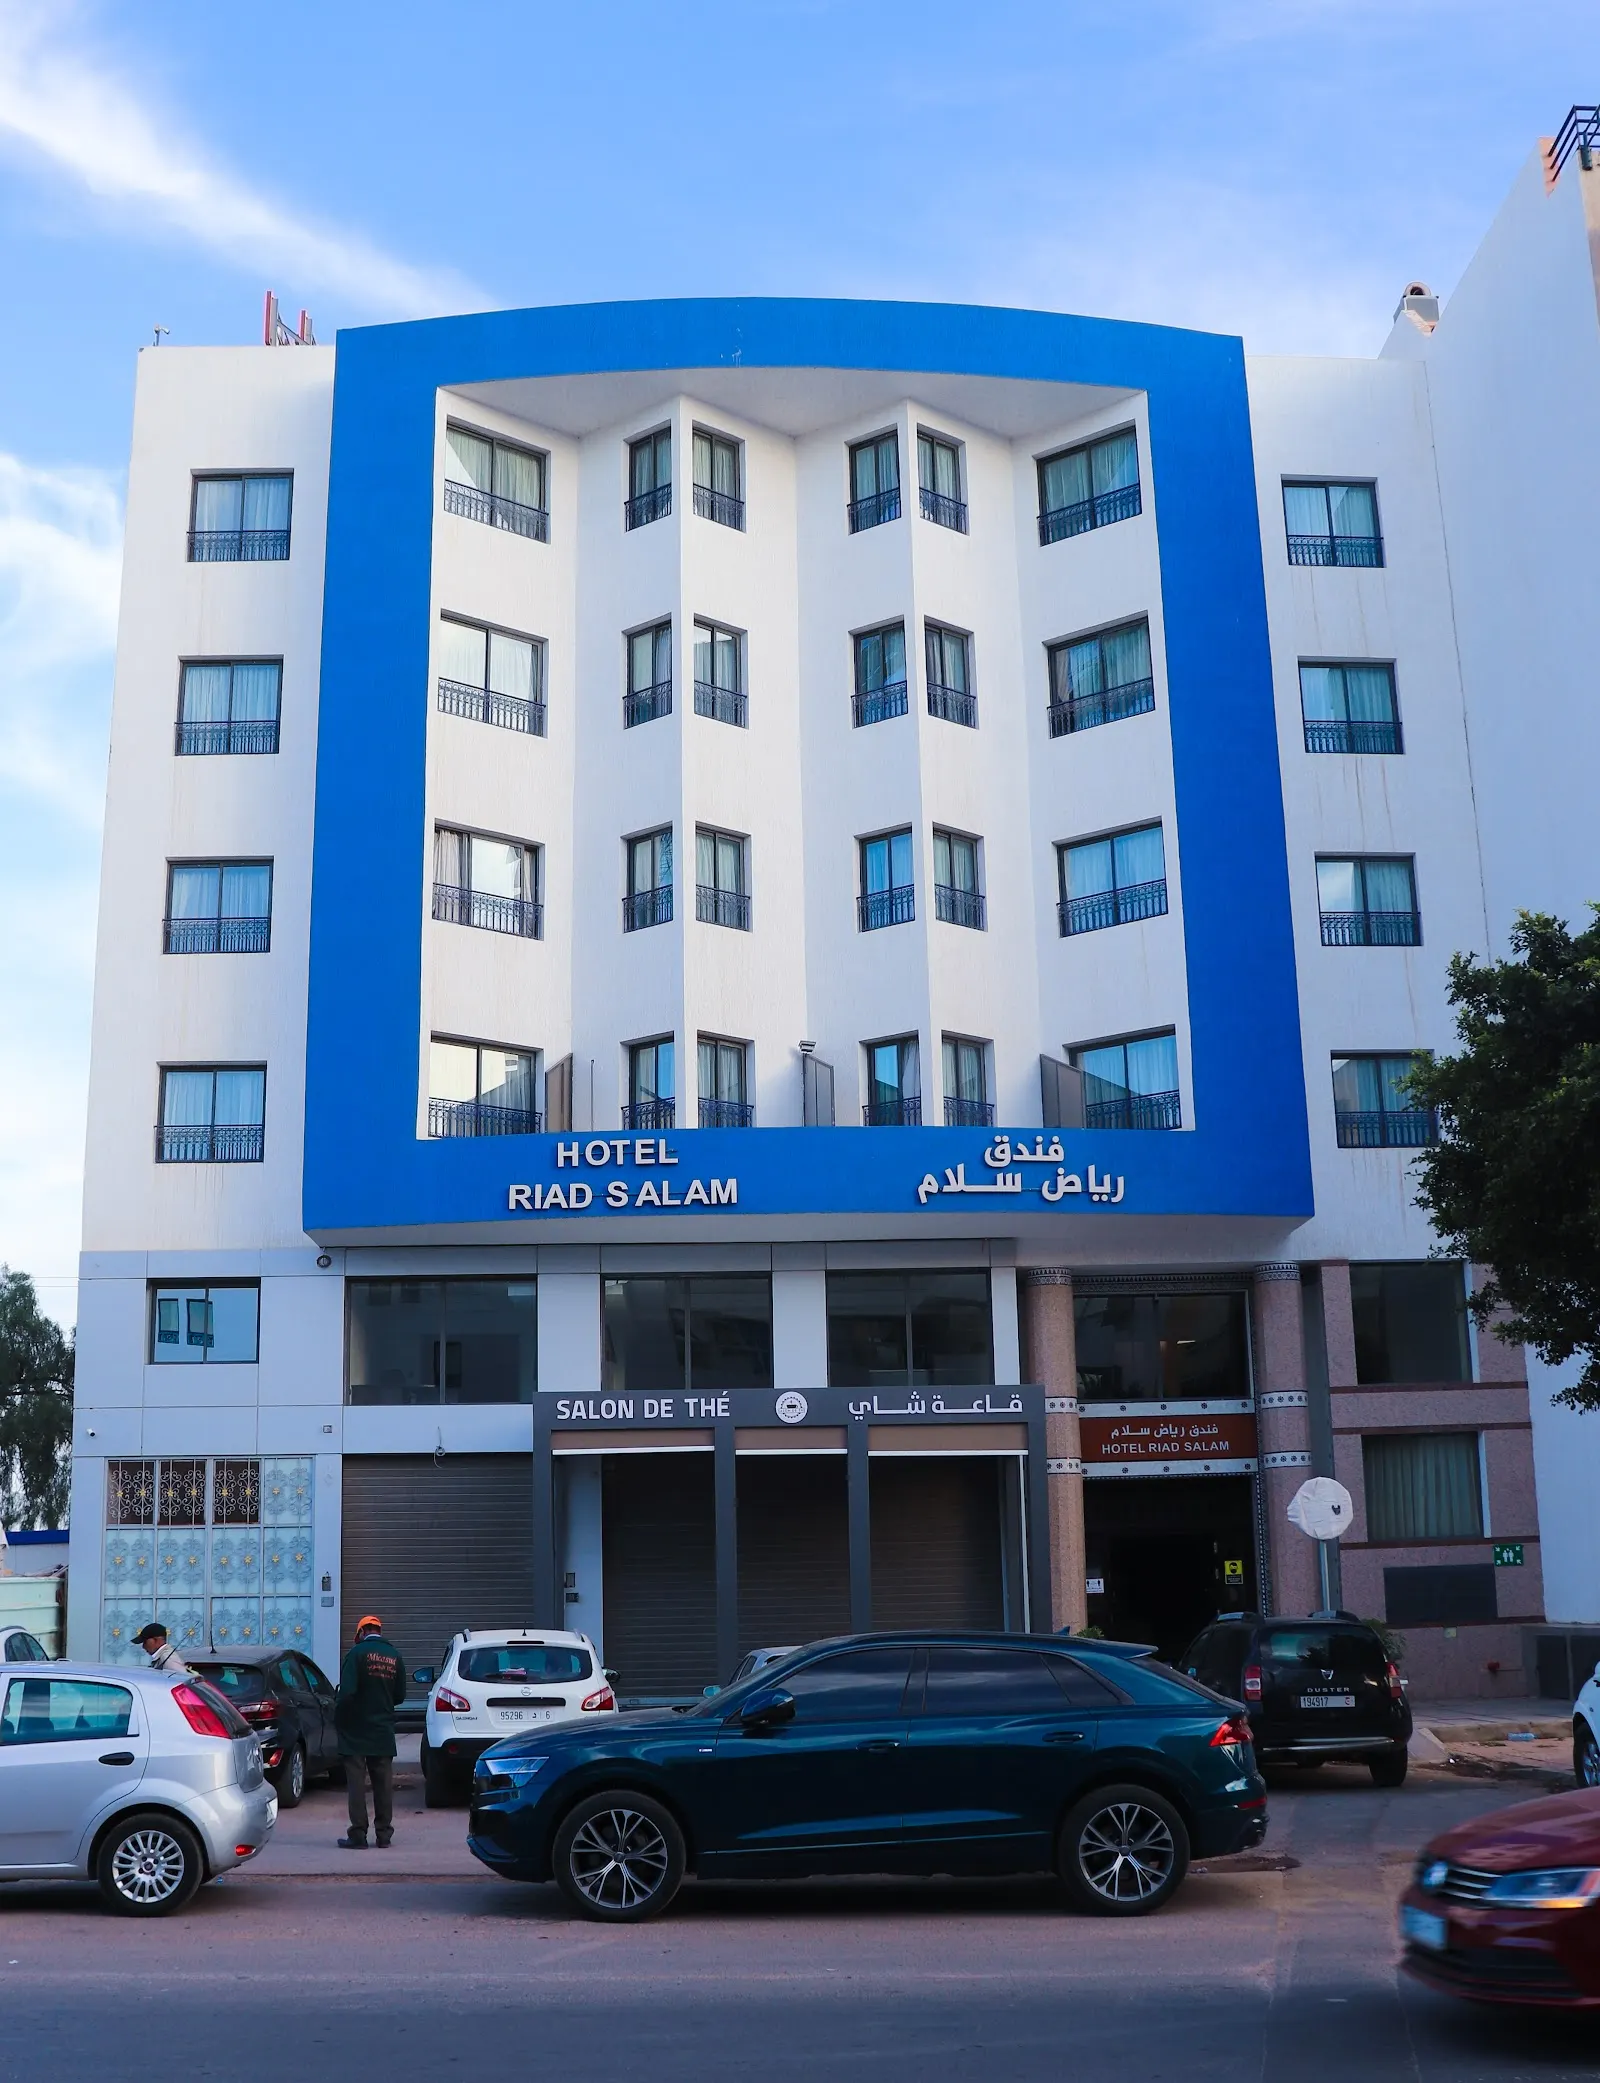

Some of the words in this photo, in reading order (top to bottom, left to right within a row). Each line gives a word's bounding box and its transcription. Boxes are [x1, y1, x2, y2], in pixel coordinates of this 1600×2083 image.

[557, 1138, 679, 1168] HOTEL
[984, 1135, 1065, 1168] فندق
[508, 1182, 593, 1210] RIAD
[606, 1178, 738, 1208] SALAM
[917, 1162, 1022, 1204] سلام
[1041, 1164, 1125, 1203] رياض
[556, 1399, 634, 1420] SALON
[643, 1398, 674, 1419] DE
[684, 1390, 730, 1418] THÉ
[848, 1390, 926, 1421] شاي
[931, 1393, 1023, 1414] قاعة
[1111, 1424, 1151, 1440] سلام
[1153, 1423, 1186, 1438] رياض
[1189, 1423, 1219, 1437] فندق
[1101, 1443, 1146, 1455] HOTEL
[1148, 1442, 1180, 1453] RIAD
[1184, 1440, 1229, 1452] SALAM
[500, 1711, 524, 1721] 95296
[545, 1710, 551, 1720] 6
